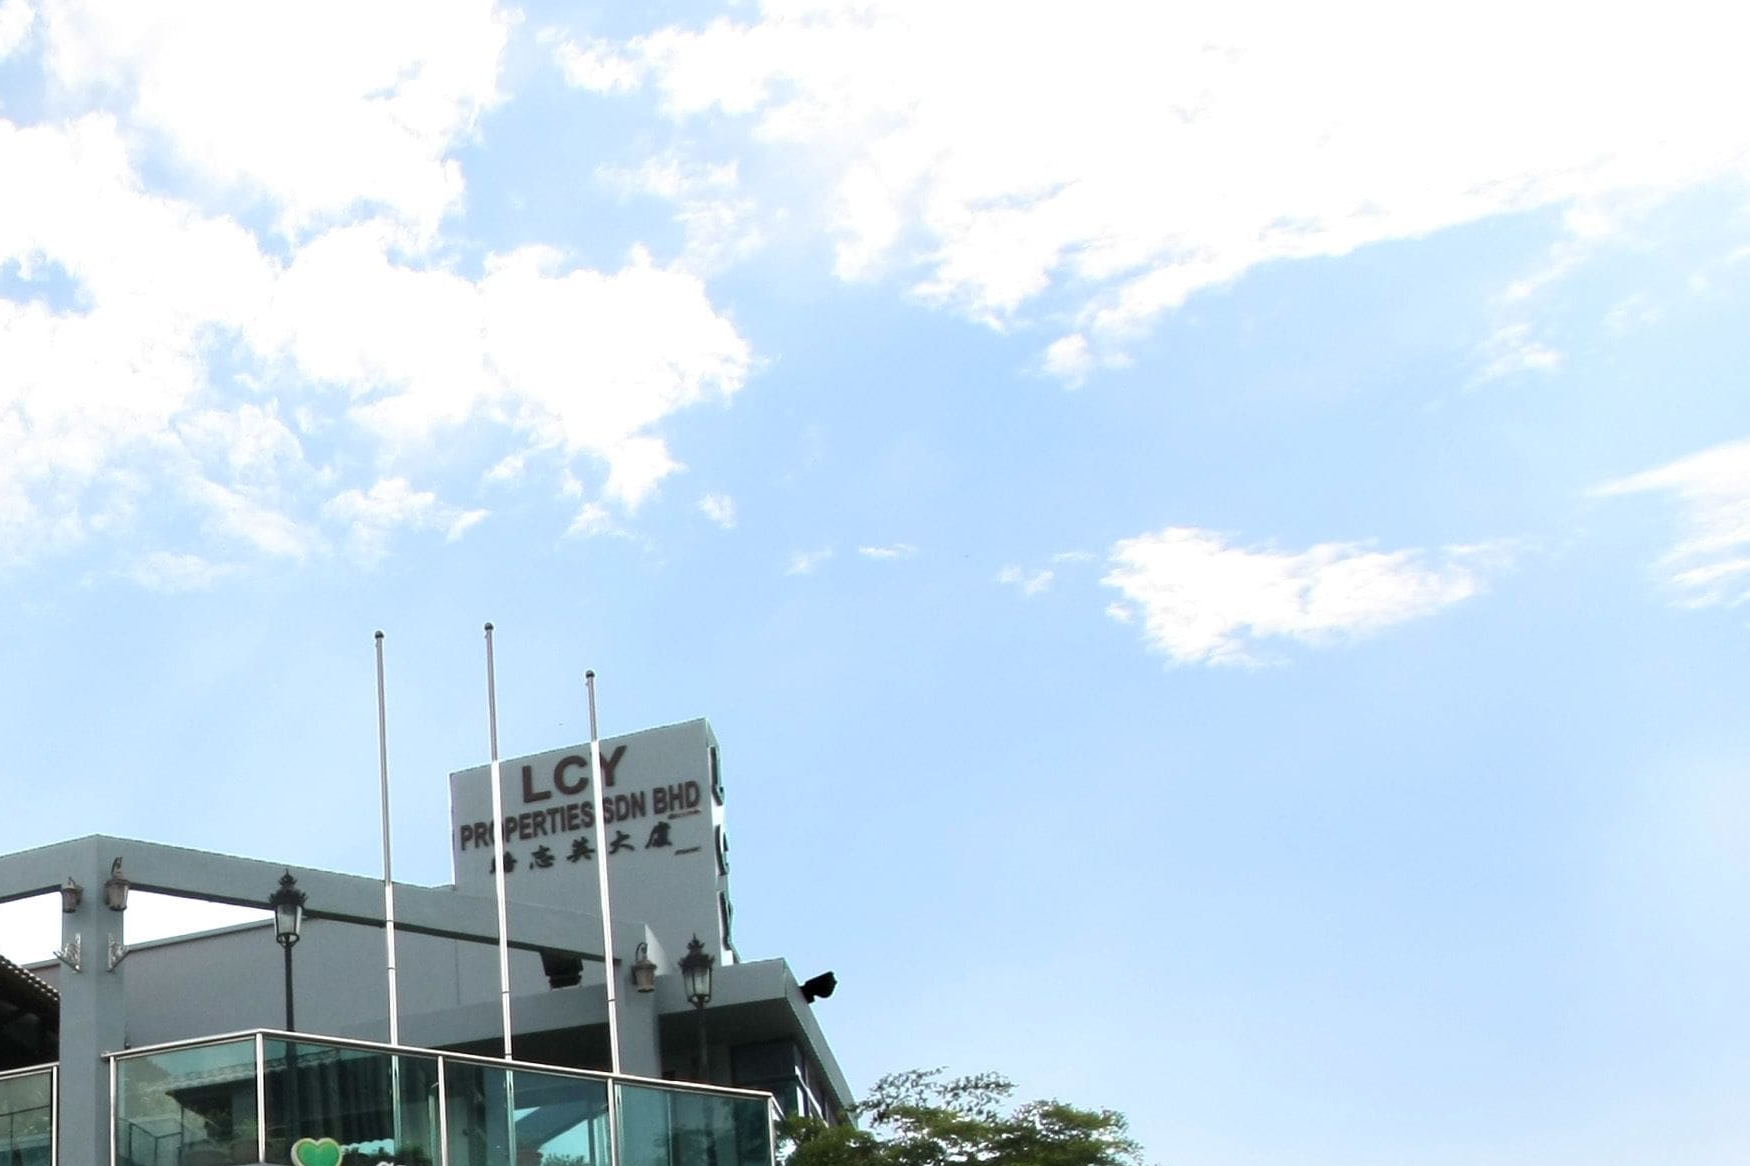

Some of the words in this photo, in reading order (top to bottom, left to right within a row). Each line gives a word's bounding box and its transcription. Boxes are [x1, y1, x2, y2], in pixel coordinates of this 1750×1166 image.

[522, 746, 627, 804] LCY
[601, 790, 646, 824] SDN
[653, 780, 701, 813] BHD
